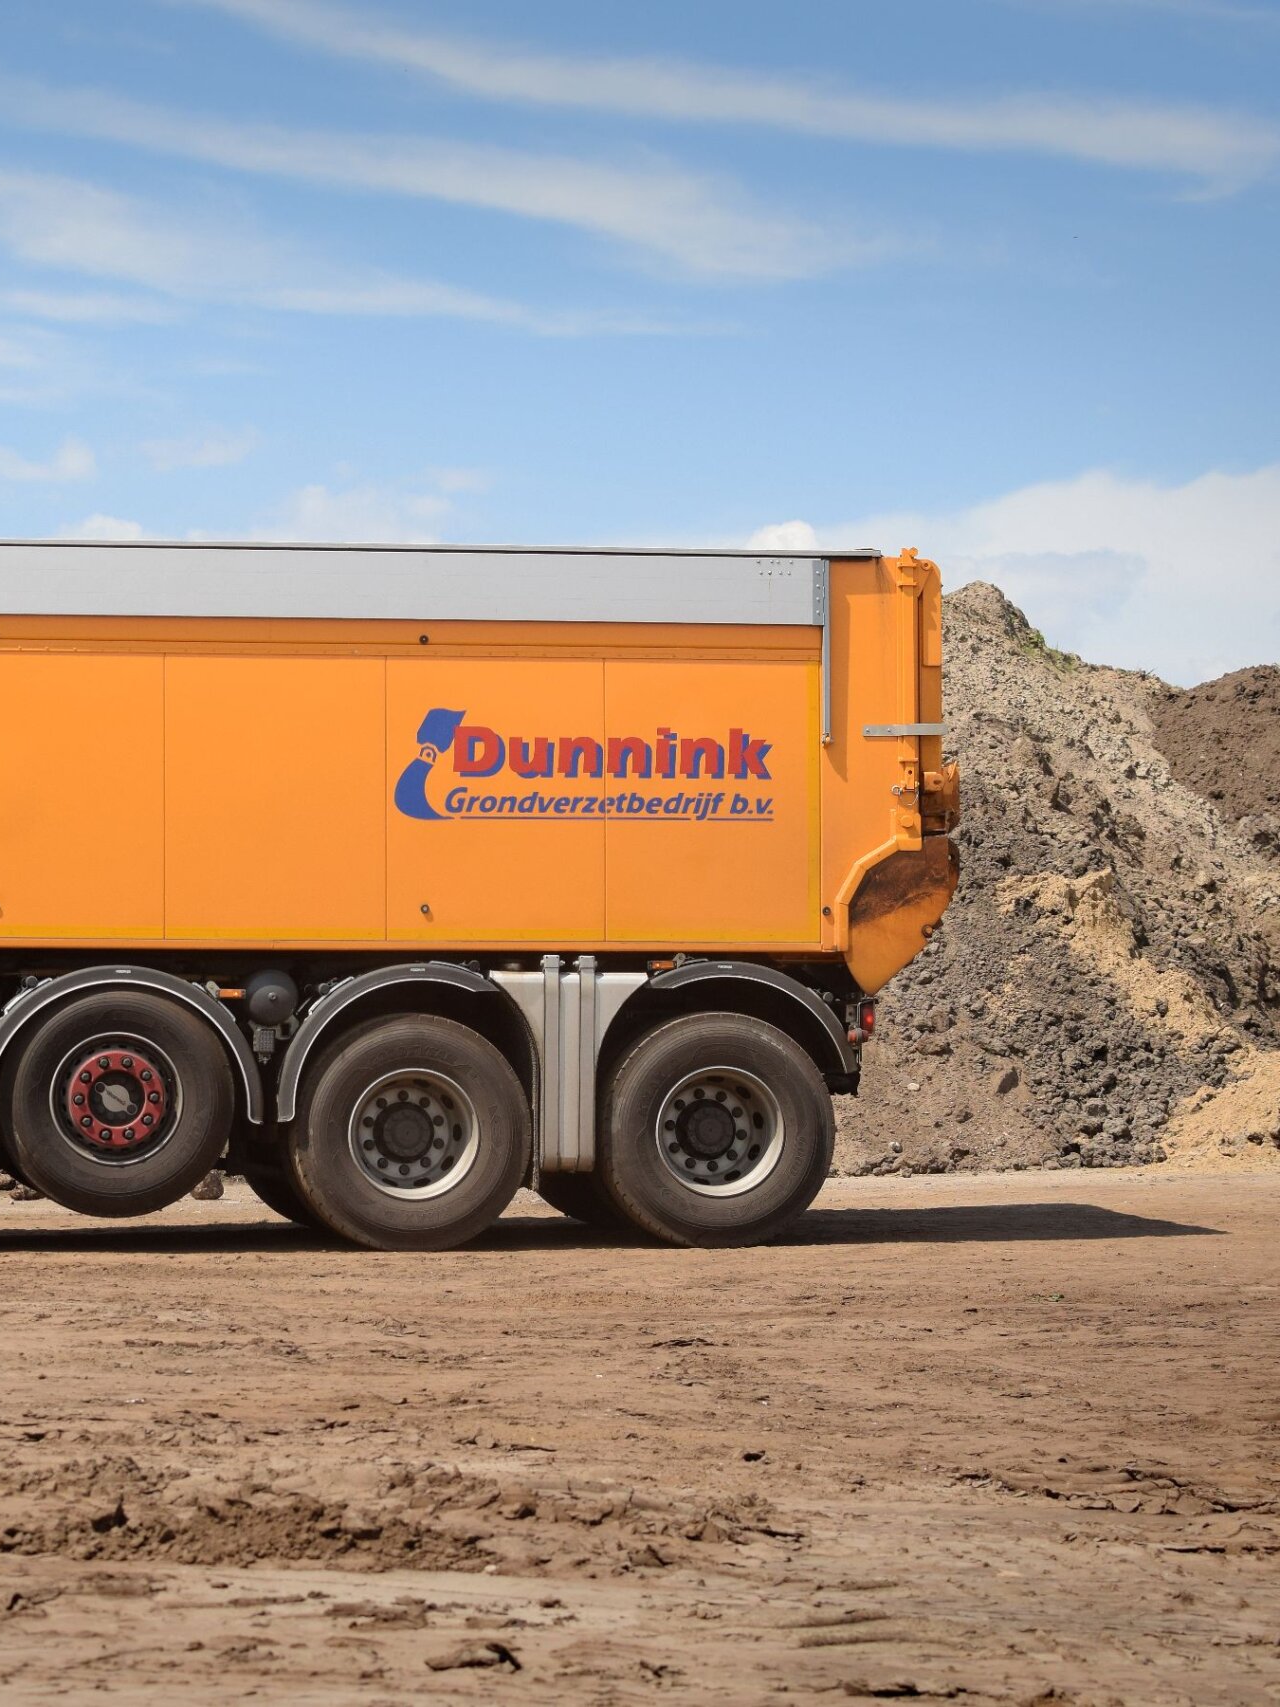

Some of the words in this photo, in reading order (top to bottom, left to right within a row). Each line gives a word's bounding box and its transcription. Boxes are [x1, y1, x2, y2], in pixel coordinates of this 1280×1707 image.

[453, 726, 773, 779] Dunnink
[445, 787, 726, 820] Grondverzetbedrijf
[730, 793, 774, 814] b.v.
